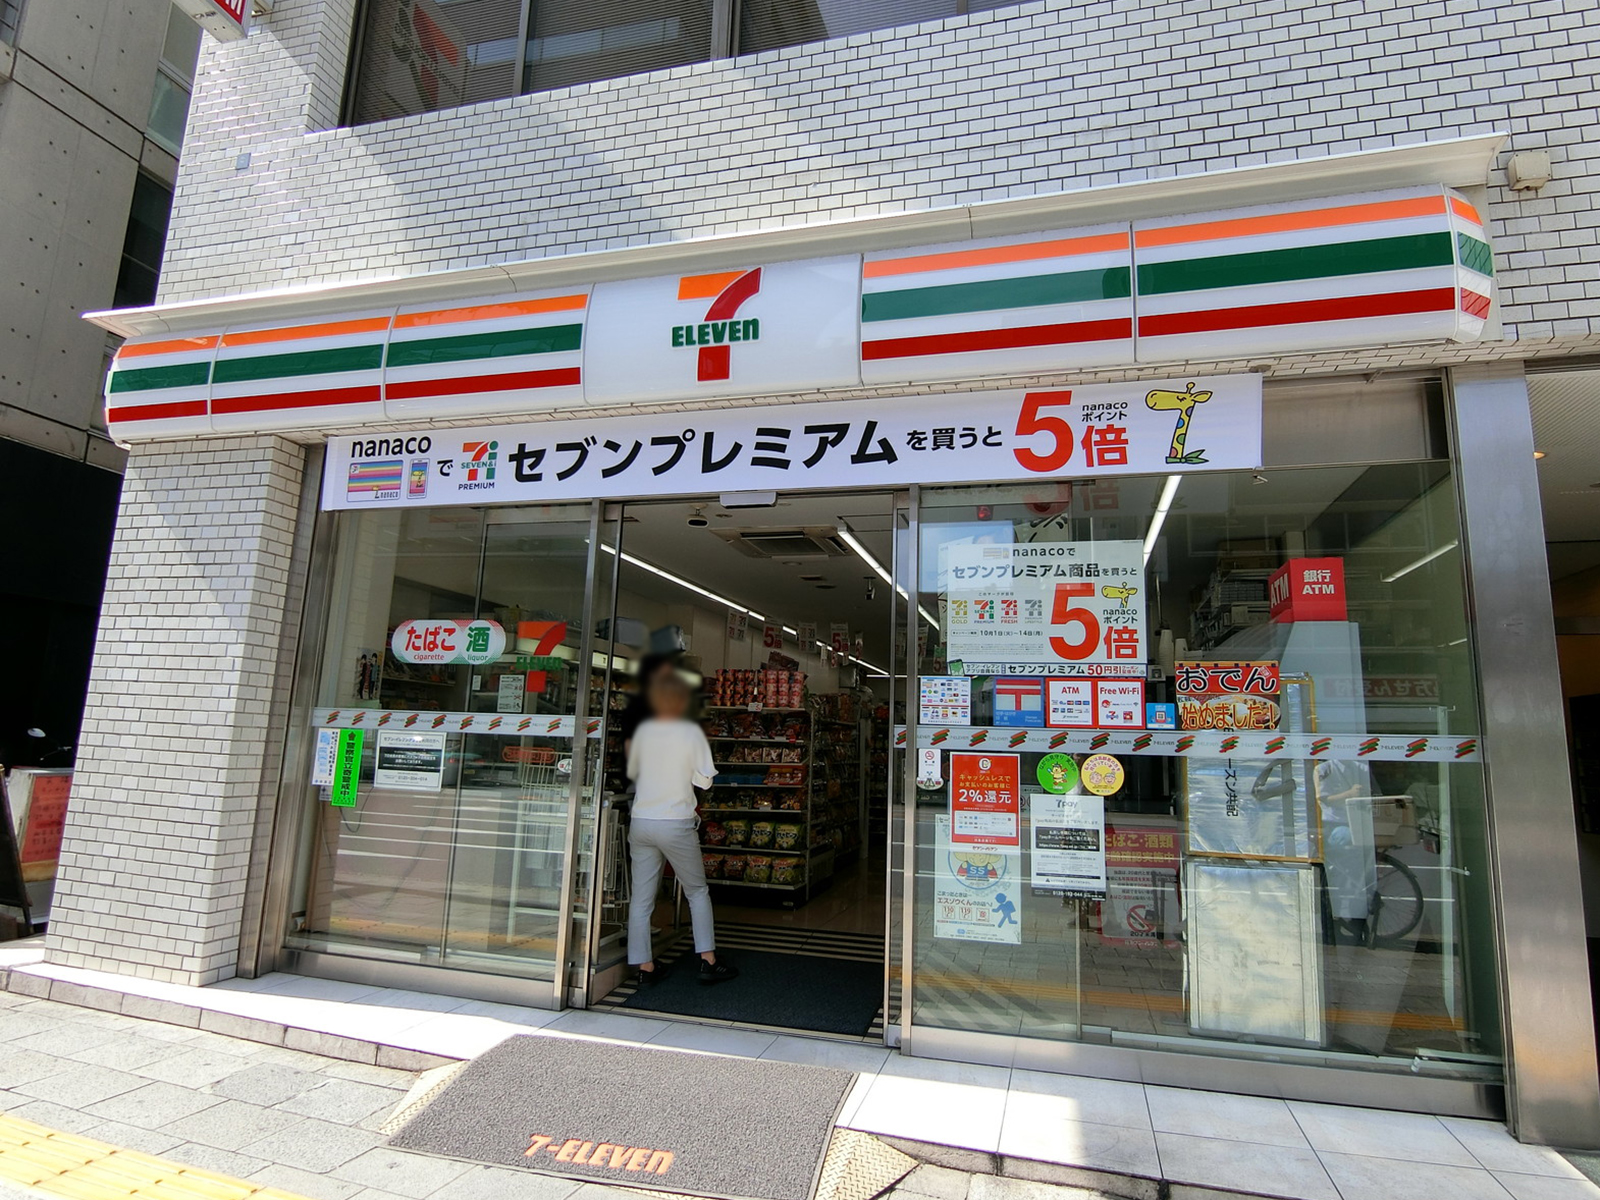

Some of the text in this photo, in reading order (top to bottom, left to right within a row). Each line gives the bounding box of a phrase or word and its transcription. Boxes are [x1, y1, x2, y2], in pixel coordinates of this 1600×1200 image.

[1082, 401, 1128, 411] nanaco
[1082, 411, 1128, 422] ポイント
[1013, 390, 1073, 472] 5
[351, 436, 431, 458] nanaco
[1081, 424, 1128, 467] 倍
[437, 459, 453, 476] で
[458, 482, 495, 490] PREMIUM
[1303, 569, 1331, 582] 銀行
[1271, 573, 1289, 608] ATM
[1302, 584, 1334, 595] ATM
[1049, 583, 1100, 660] 5
[1103, 616, 1138, 624] ポイント
[405, 626, 490, 652] たばこ 酒
[1103, 626, 1139, 659] 倍
[467, 654, 488, 662] liquor
[1176, 667, 1276, 692] おでん
[1118, 687, 1140, 695] Wi-Fi
[959, 774, 1011, 782] キャッシュレスで
[1056, 799, 1077, 808] 7pay
[970, 866, 985, 875] SS
